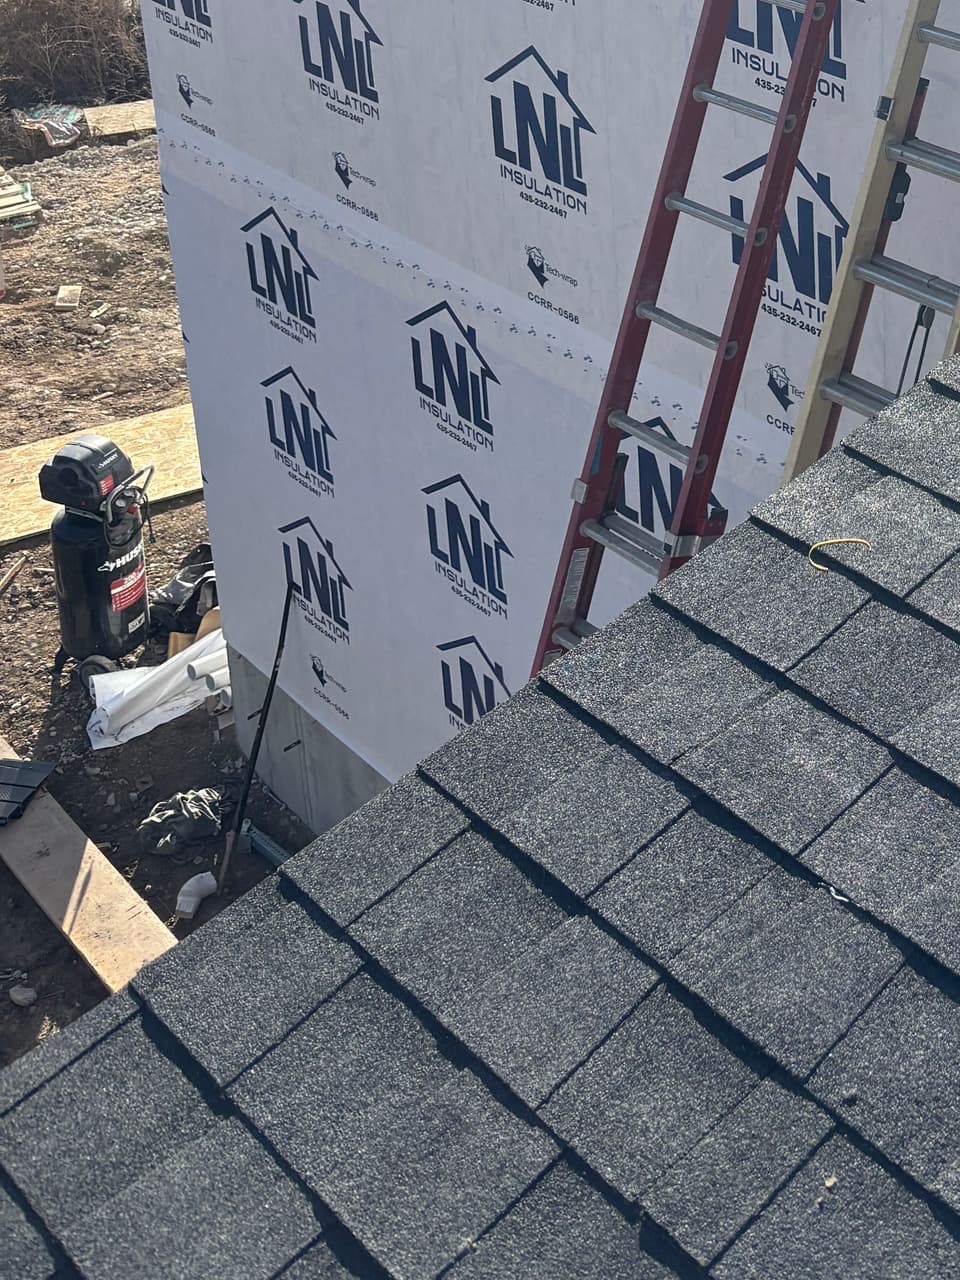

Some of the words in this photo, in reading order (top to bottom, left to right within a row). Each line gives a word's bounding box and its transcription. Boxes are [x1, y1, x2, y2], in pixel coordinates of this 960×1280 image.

[155, 7, 213, 44] INSULATION
[309, 78, 380, 120] INSULATION
[732, 47, 845, 101] INSULON
[500, 164, 587, 215] INSULATION
[520, 191, 567, 218] 435-232-2467
[256, 297, 316, 343] INSULATION
[761, 303, 822, 337] 435-232-2467
[420, 396, 493, 451] INSULATION
[274, 449, 334, 498] INSULATION
[435, 561, 507, 619] INSULATION
[293, 594, 349, 645] NSULATION
[441, 656, 495, 725] LN
